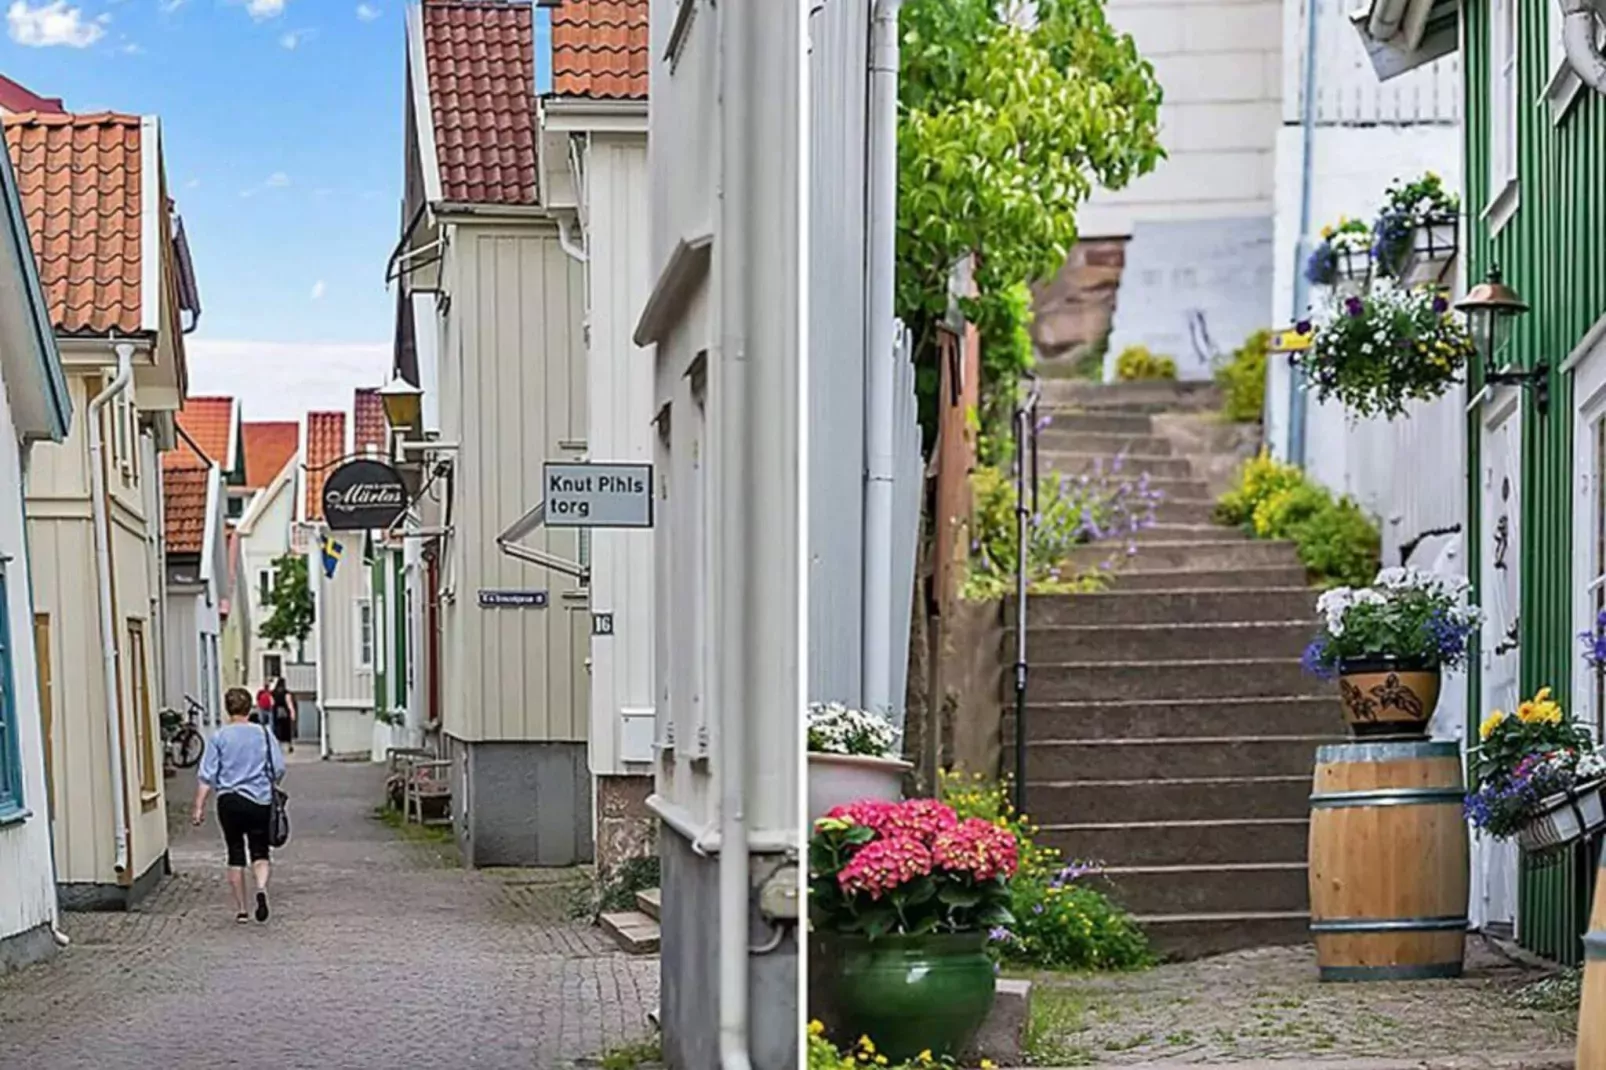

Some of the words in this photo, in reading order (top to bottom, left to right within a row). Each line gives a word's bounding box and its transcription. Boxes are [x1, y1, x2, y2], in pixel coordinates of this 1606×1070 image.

[550, 475, 592, 492] Knut
[598, 475, 644, 493] Pihls
[551, 498, 590, 517] torg
[595, 616, 611, 632] 16
